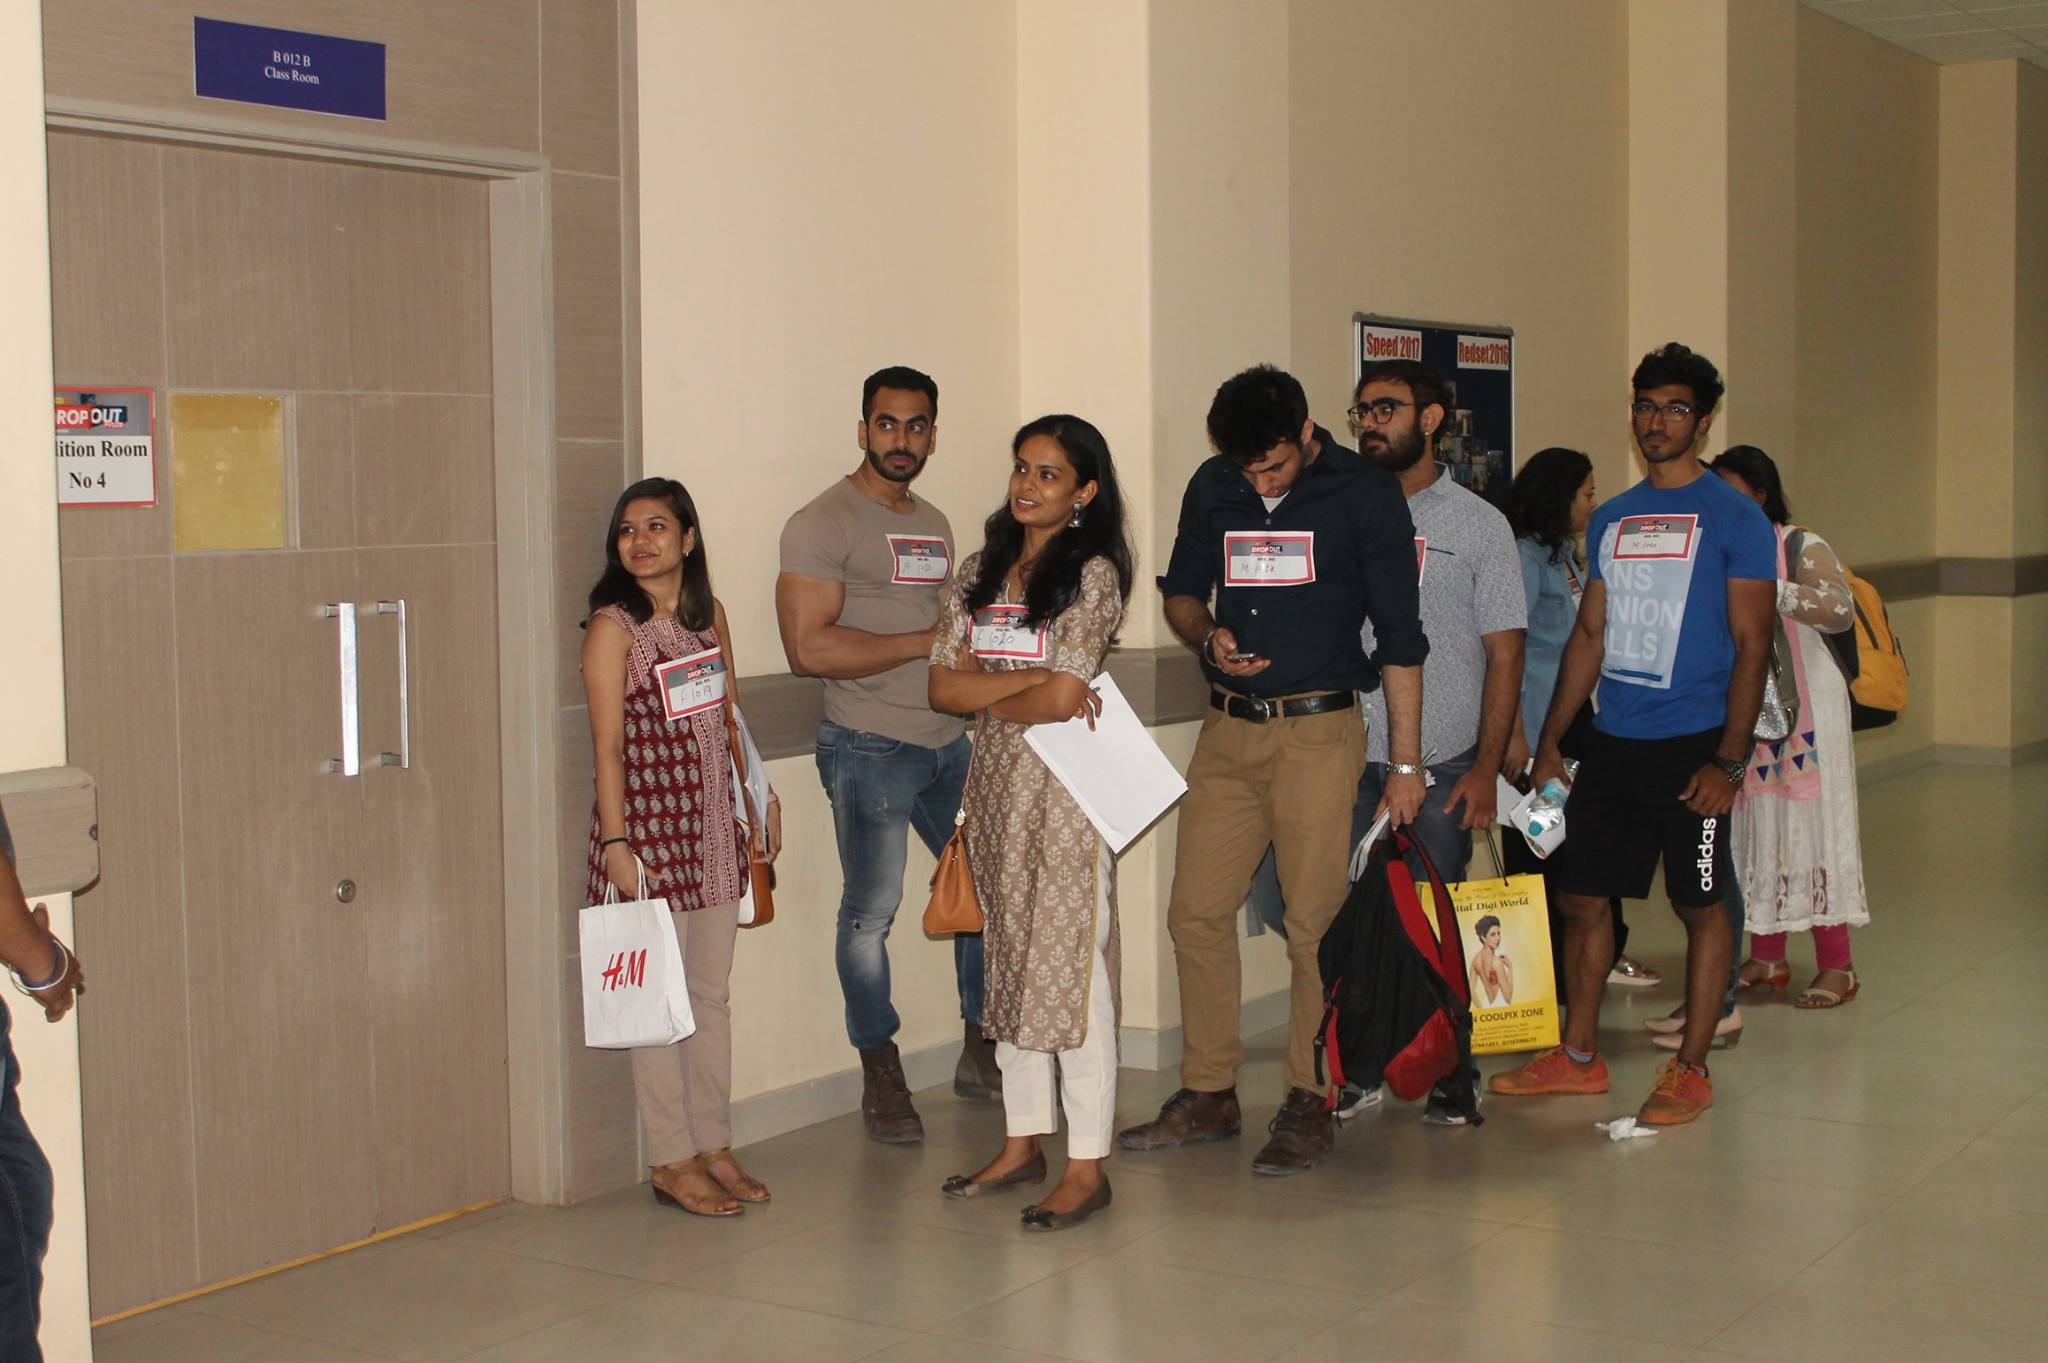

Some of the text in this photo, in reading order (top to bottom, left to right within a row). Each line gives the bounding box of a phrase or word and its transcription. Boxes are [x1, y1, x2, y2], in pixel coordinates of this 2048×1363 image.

[273, 50, 311, 67] B 012 B
[264, 66, 320, 85] Class Room
[1366, 332, 1420, 361] Speed 2017
[56, 407, 123, 425] ROP OUT
[101, 440, 148, 457] Room
[69, 471, 106, 489] No 4
[1604, 627, 1659, 662] LLS
[1697, 817, 1717, 892] adidas
[1456, 902, 1473, 913] ital
[1500, 896, 1529, 908] World
[601, 948, 648, 993] H&M
[1480, 1010, 1519, 1023] COOLPIX
[1521, 1006, 1545, 1018] ZONE
